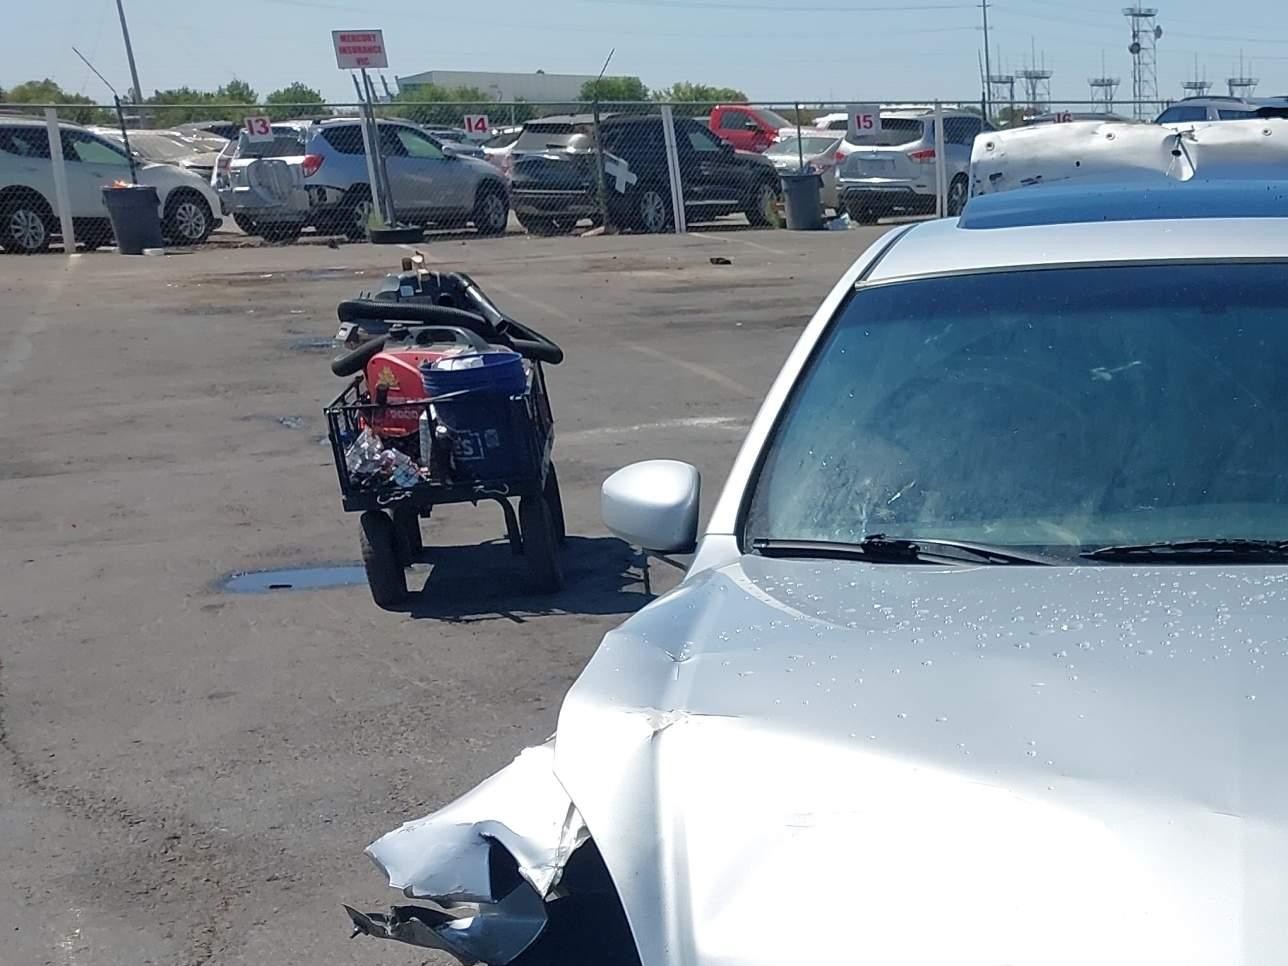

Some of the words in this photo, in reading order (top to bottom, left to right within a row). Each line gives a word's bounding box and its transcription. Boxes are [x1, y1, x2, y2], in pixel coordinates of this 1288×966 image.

[338, 45, 382, 55] INSURANCE
[247, 118, 269, 135] 13
[466, 117, 488, 133] 14
[856, 114, 873, 129] 15
